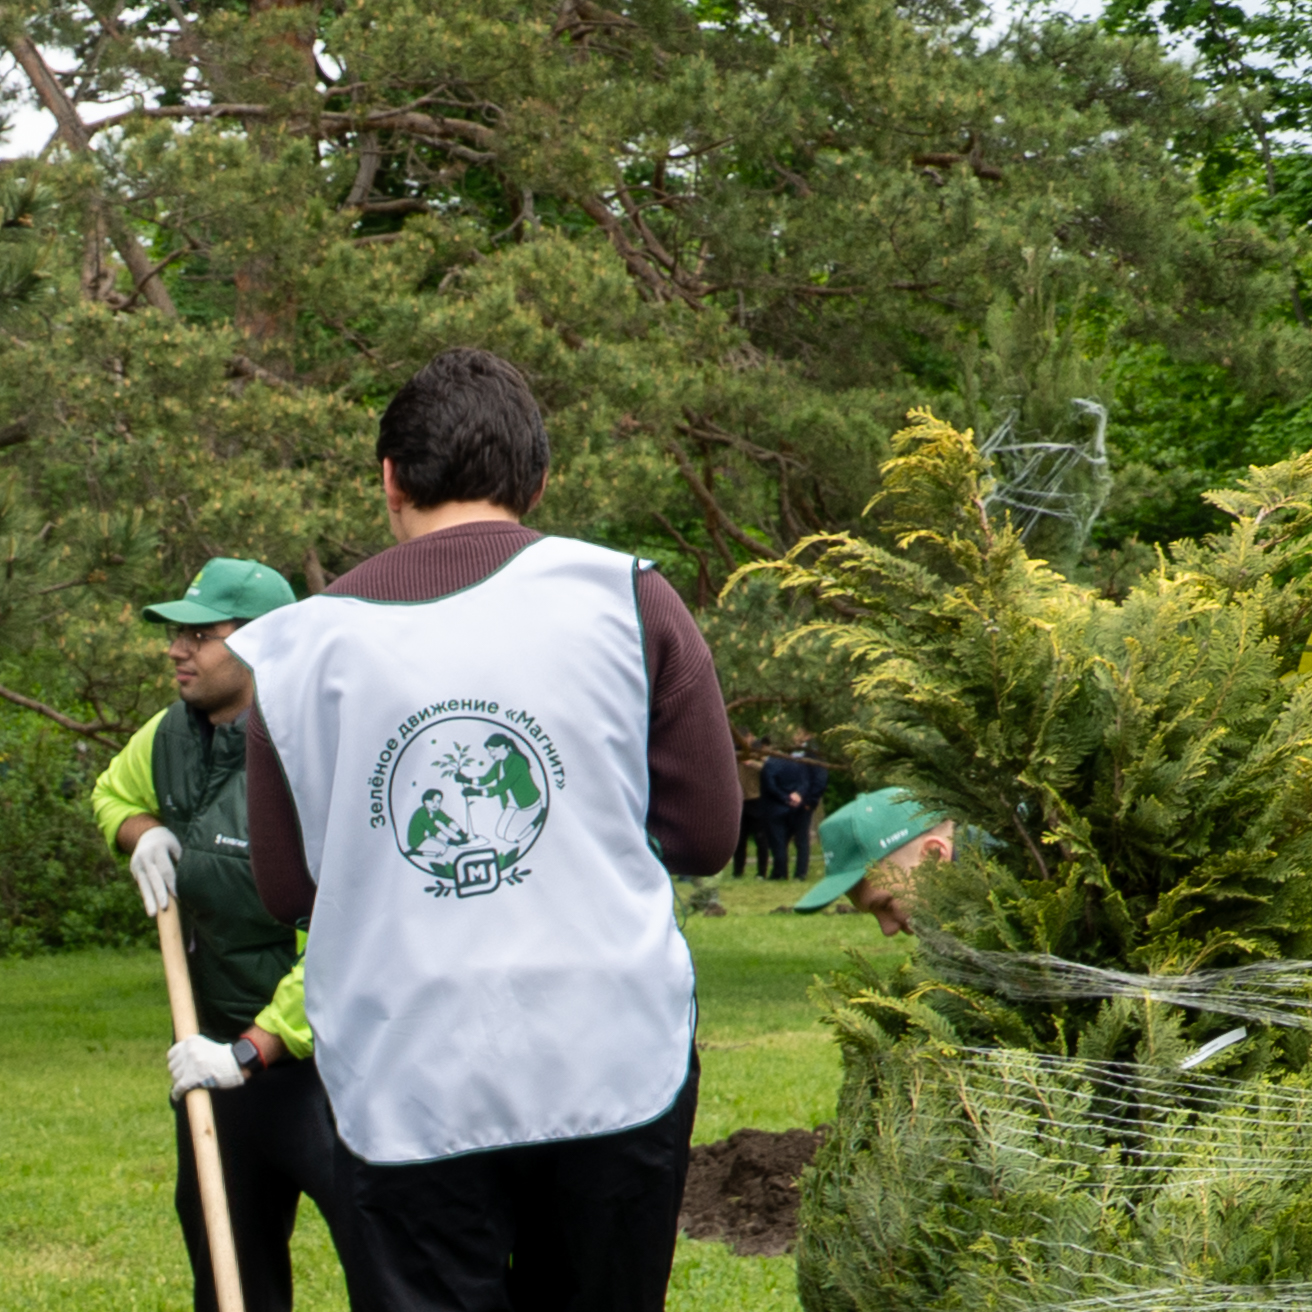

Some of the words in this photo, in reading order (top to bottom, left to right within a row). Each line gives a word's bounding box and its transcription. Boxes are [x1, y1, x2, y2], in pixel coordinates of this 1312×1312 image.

[368, 738, 398, 828] Зелёное
[398, 699, 499, 739] движение
[505, 708, 566, 790] «Магнит»
